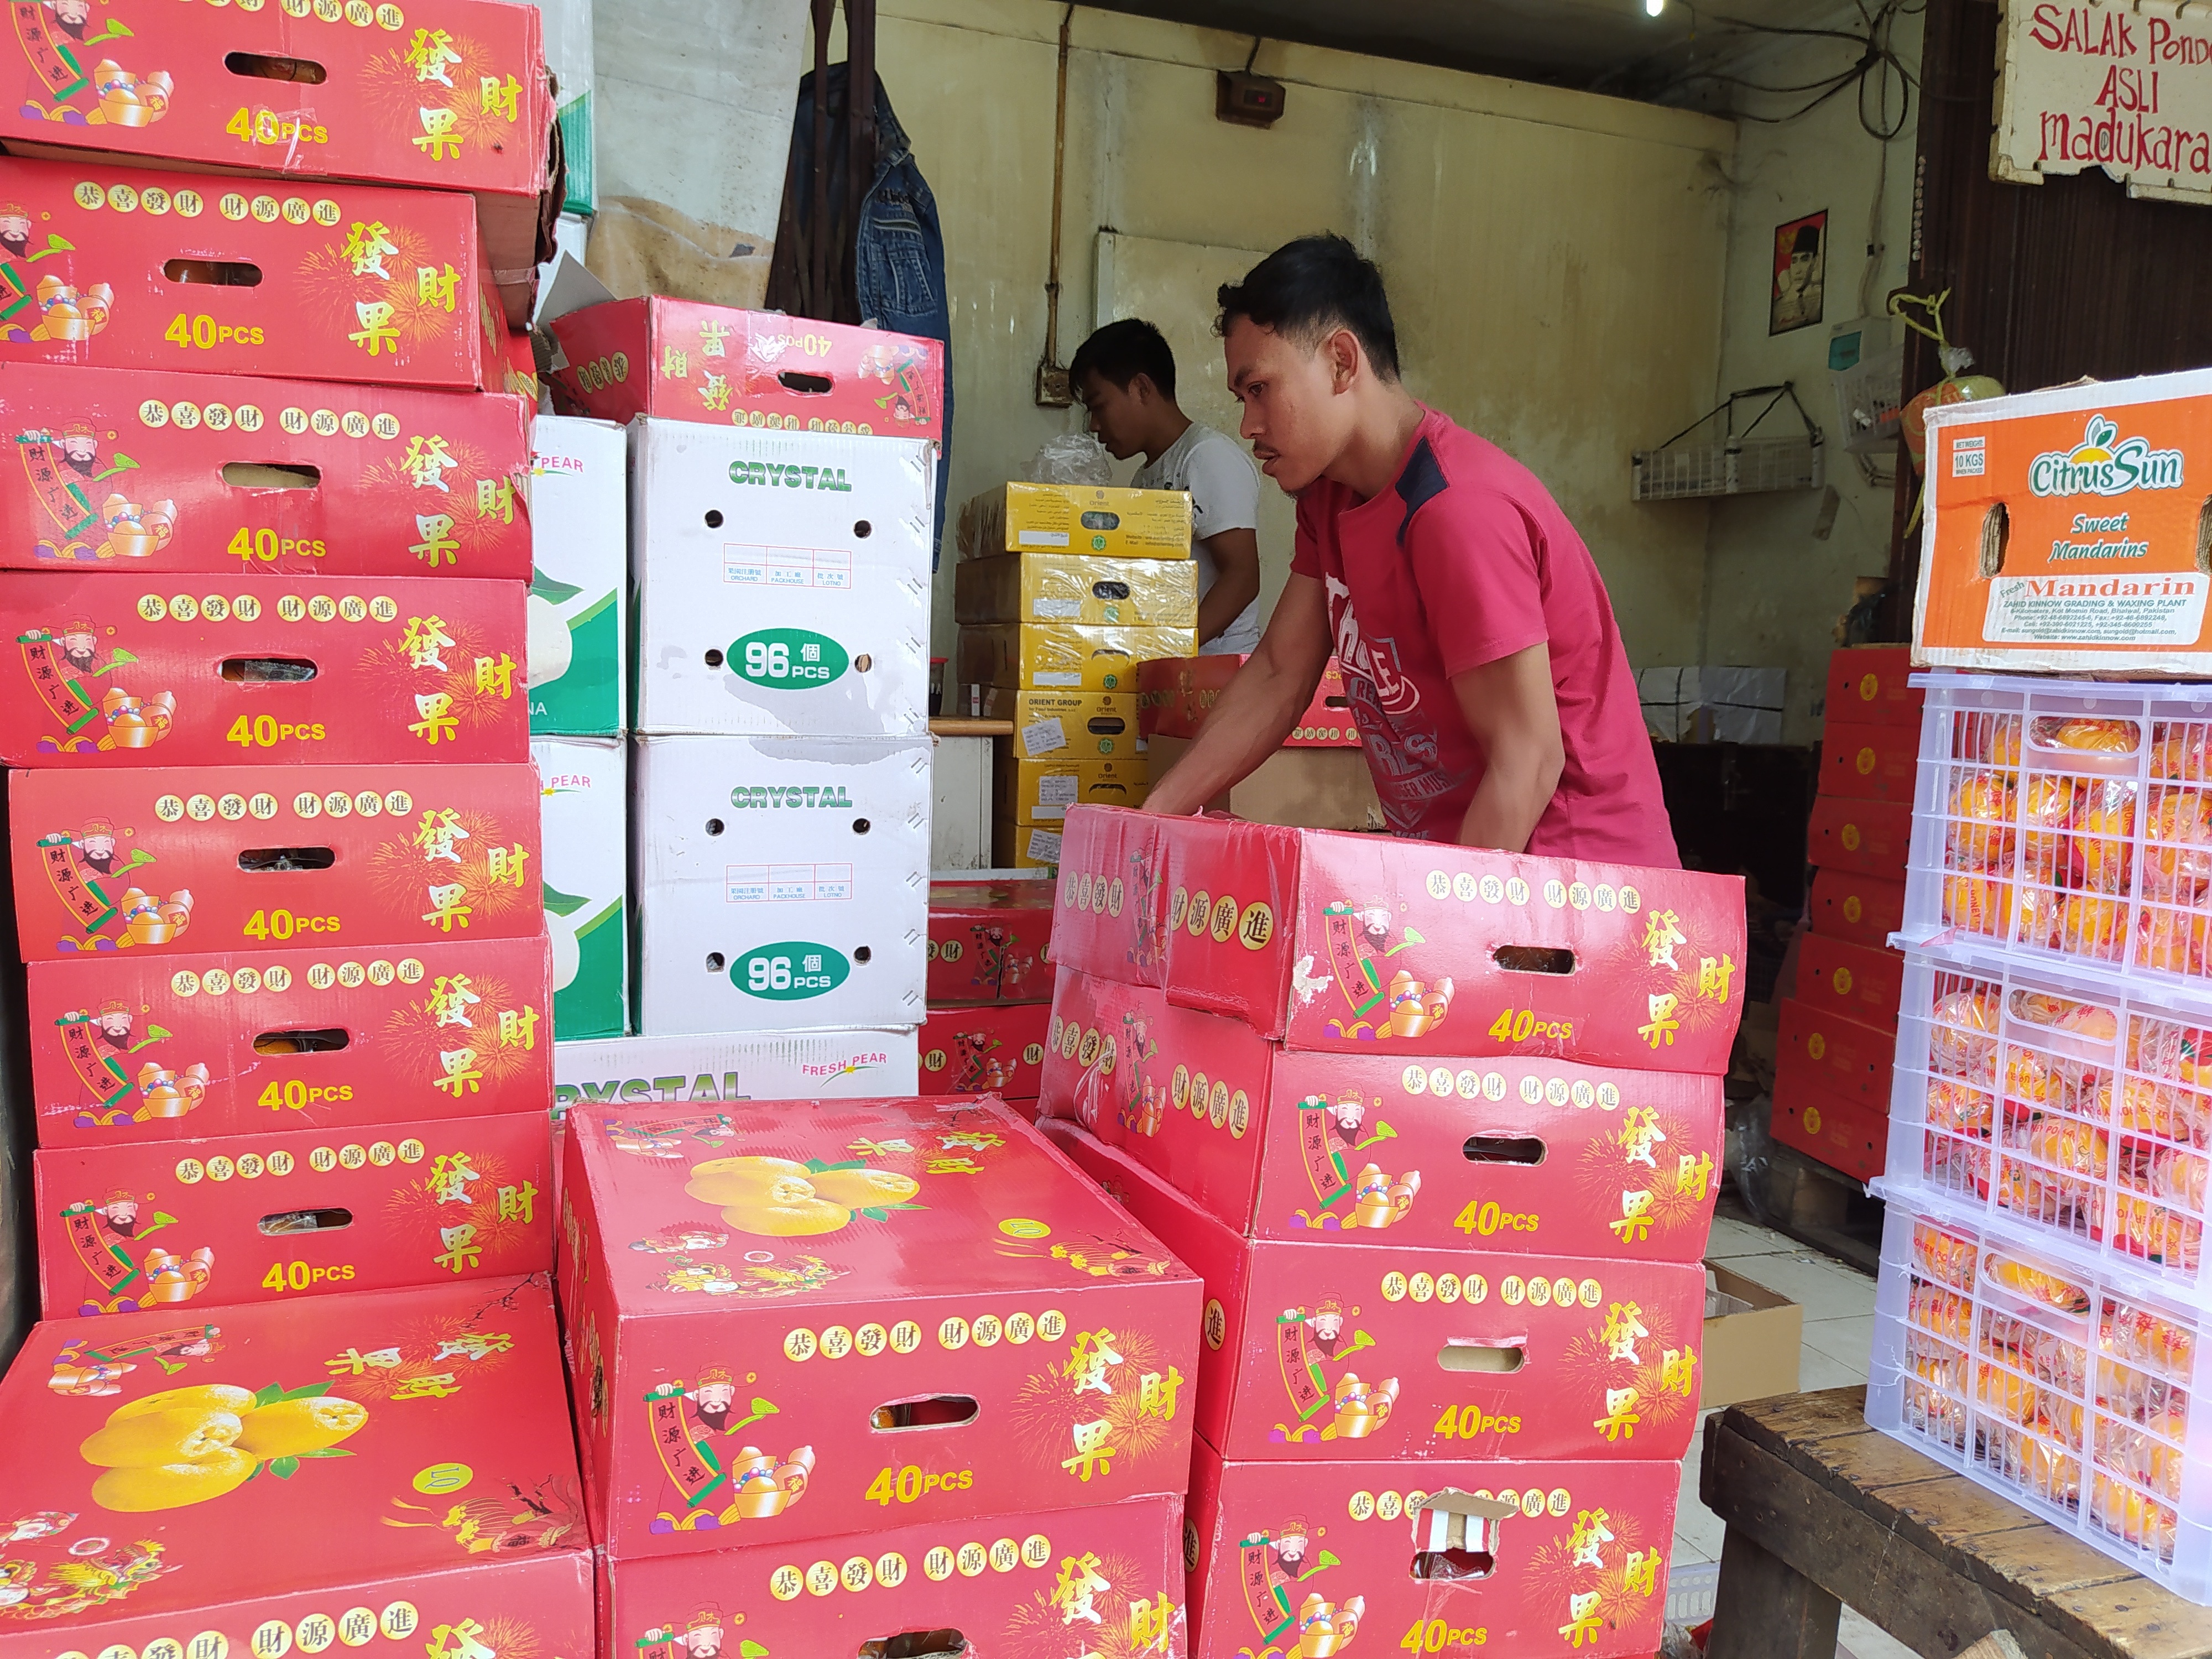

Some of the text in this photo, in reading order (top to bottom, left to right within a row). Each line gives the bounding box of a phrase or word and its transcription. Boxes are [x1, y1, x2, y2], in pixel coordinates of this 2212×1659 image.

[2028, 4, 2137, 59] SALAK
[2094, 64, 2158, 113] ASLI
[79, 187, 337, 221] 恭喜發財 財源廣進
[142, 405, 396, 434] 恭喜發財 財源廣進
[541, 457, 583, 473] PEAR
[1955, 454, 1983, 468] 10 KGS
[729, 461, 852, 492] CRYSTAL
[2072, 513, 2128, 534] Sweet
[2048, 539, 2148, 563] Mandarins
[2000, 577, 2195, 598] Fresh Mandarin
[140, 599, 393, 617] 恭喜發財 財源廣進
[745, 642, 789, 678] 96
[800, 643, 821, 661] 個
[792, 666, 830, 679] PCS
[551, 775, 591, 788] PEAR
[158, 795, 409, 816] 恭喜發財 財源廣進
[731, 786, 852, 808] CRYSTAL
[1431, 877, 1637, 909] 恭喜發財 財源廣進
[748, 956, 791, 991] 96
[802, 954, 822, 972] 個
[174, 963, 420, 992] 恭喜發財 財源廣進
[794, 975, 831, 988] PCS
[802, 1052, 887, 1076] FRESH PEAR
[1406, 1072, 1618, 1105] 恭喜發財 財源廣進
[1173, 1072, 1246, 1133] 財源廣進
[179, 1142, 420, 1179] 恭喜發財 財源廣進
[1385, 1278, 1600, 1302] 恭喜發財 財源廣進
[789, 1315, 1062, 1355] 恭喜發財 財源廣進
[1353, 1495, 1428, 1515] 恭喜發
[776, 1540, 1046, 1594] 恭喜發財 財源廣進
[258, 1606, 413, 1655] 財源廣進
